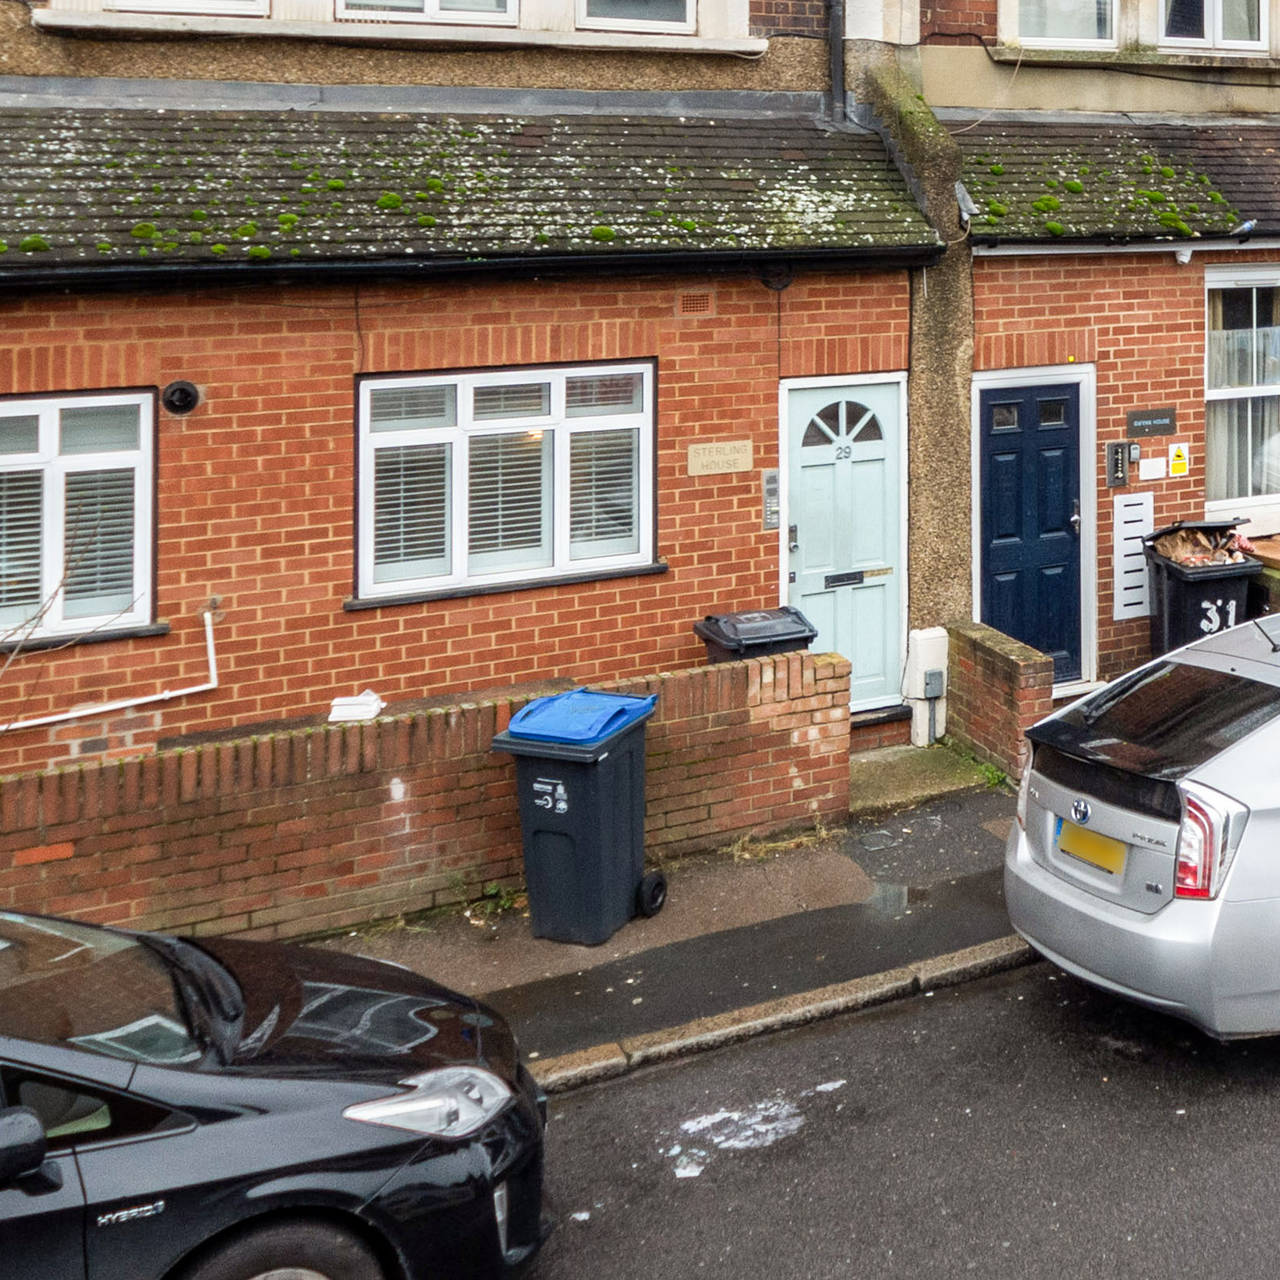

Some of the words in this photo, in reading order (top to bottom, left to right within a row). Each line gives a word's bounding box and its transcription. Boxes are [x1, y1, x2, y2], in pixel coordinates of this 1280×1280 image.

[693, 444, 748, 458] STERLING
[835, 445, 852, 460] 29
[701, 458, 740, 471] HOUSE
[96, 1204, 154, 1227] HYBRID
